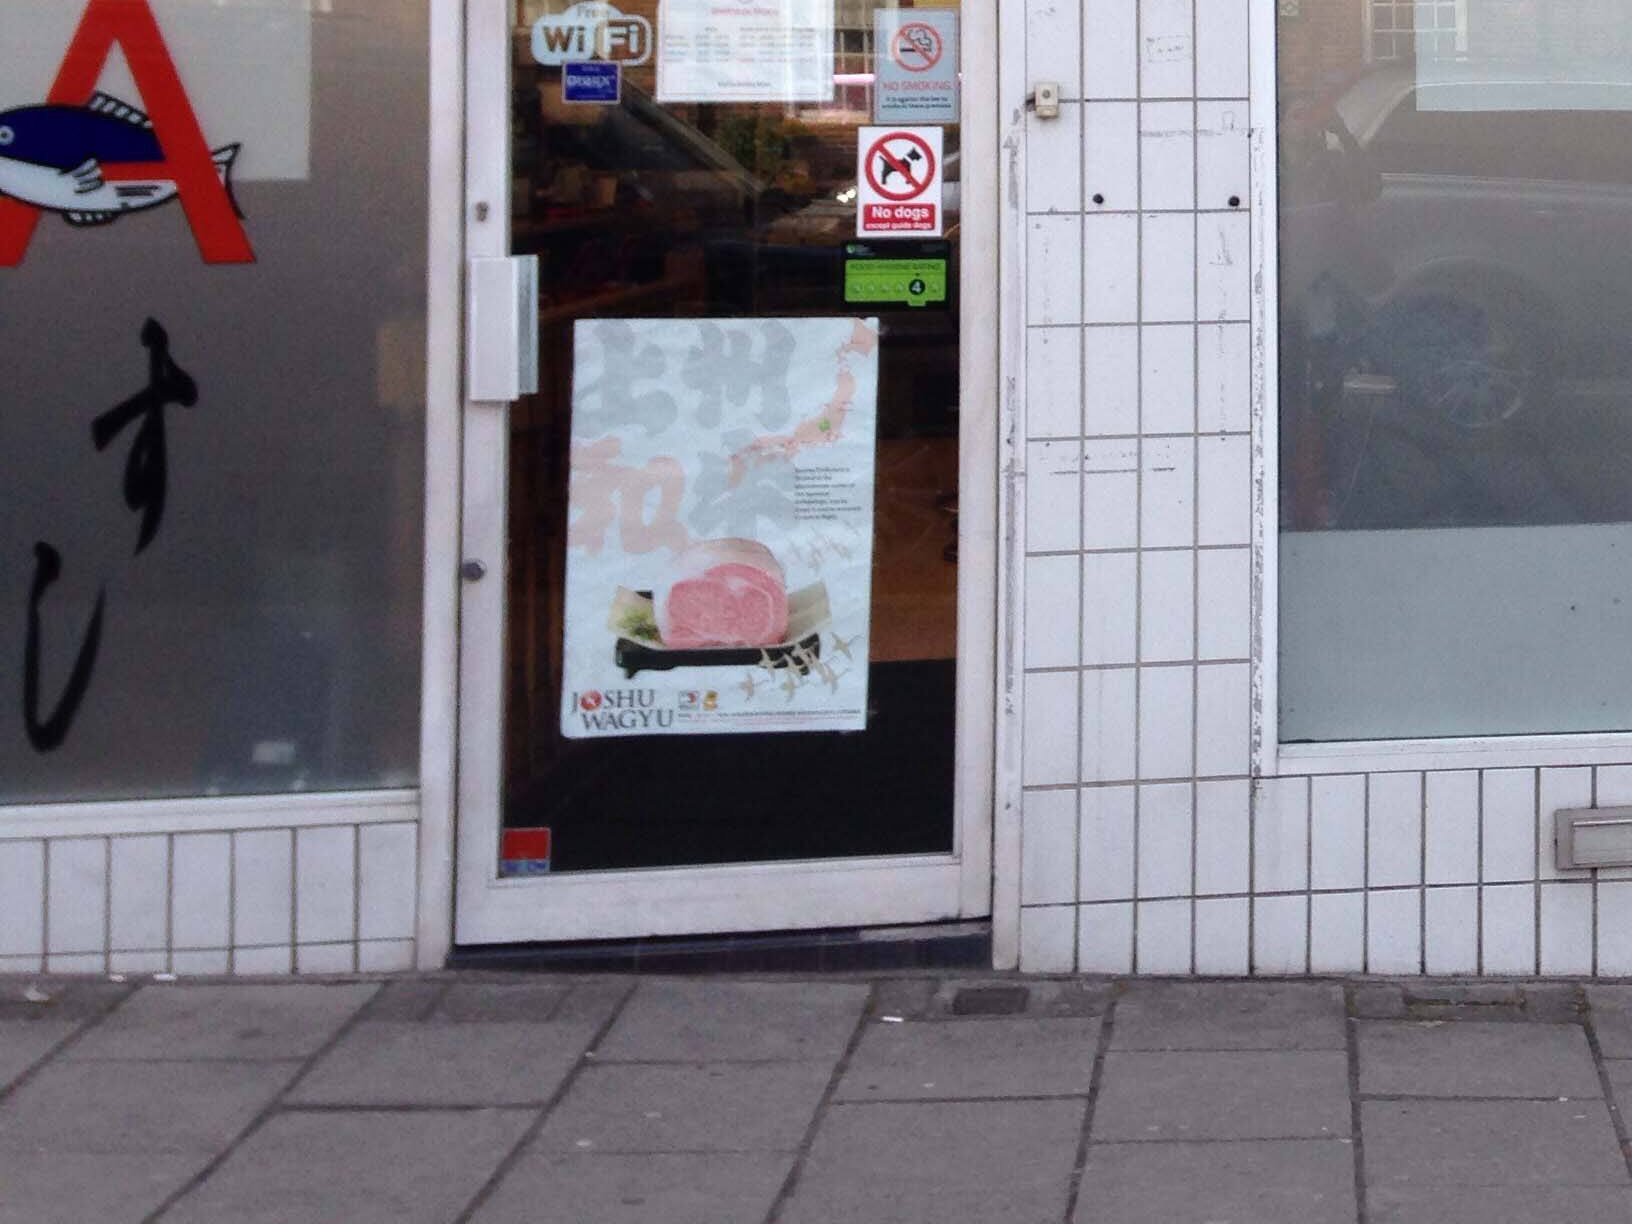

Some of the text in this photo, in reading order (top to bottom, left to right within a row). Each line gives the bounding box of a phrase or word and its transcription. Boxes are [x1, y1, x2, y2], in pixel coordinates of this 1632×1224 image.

[871, 206, 929, 221] No dogs
[581, 707, 674, 730] WAGYU
